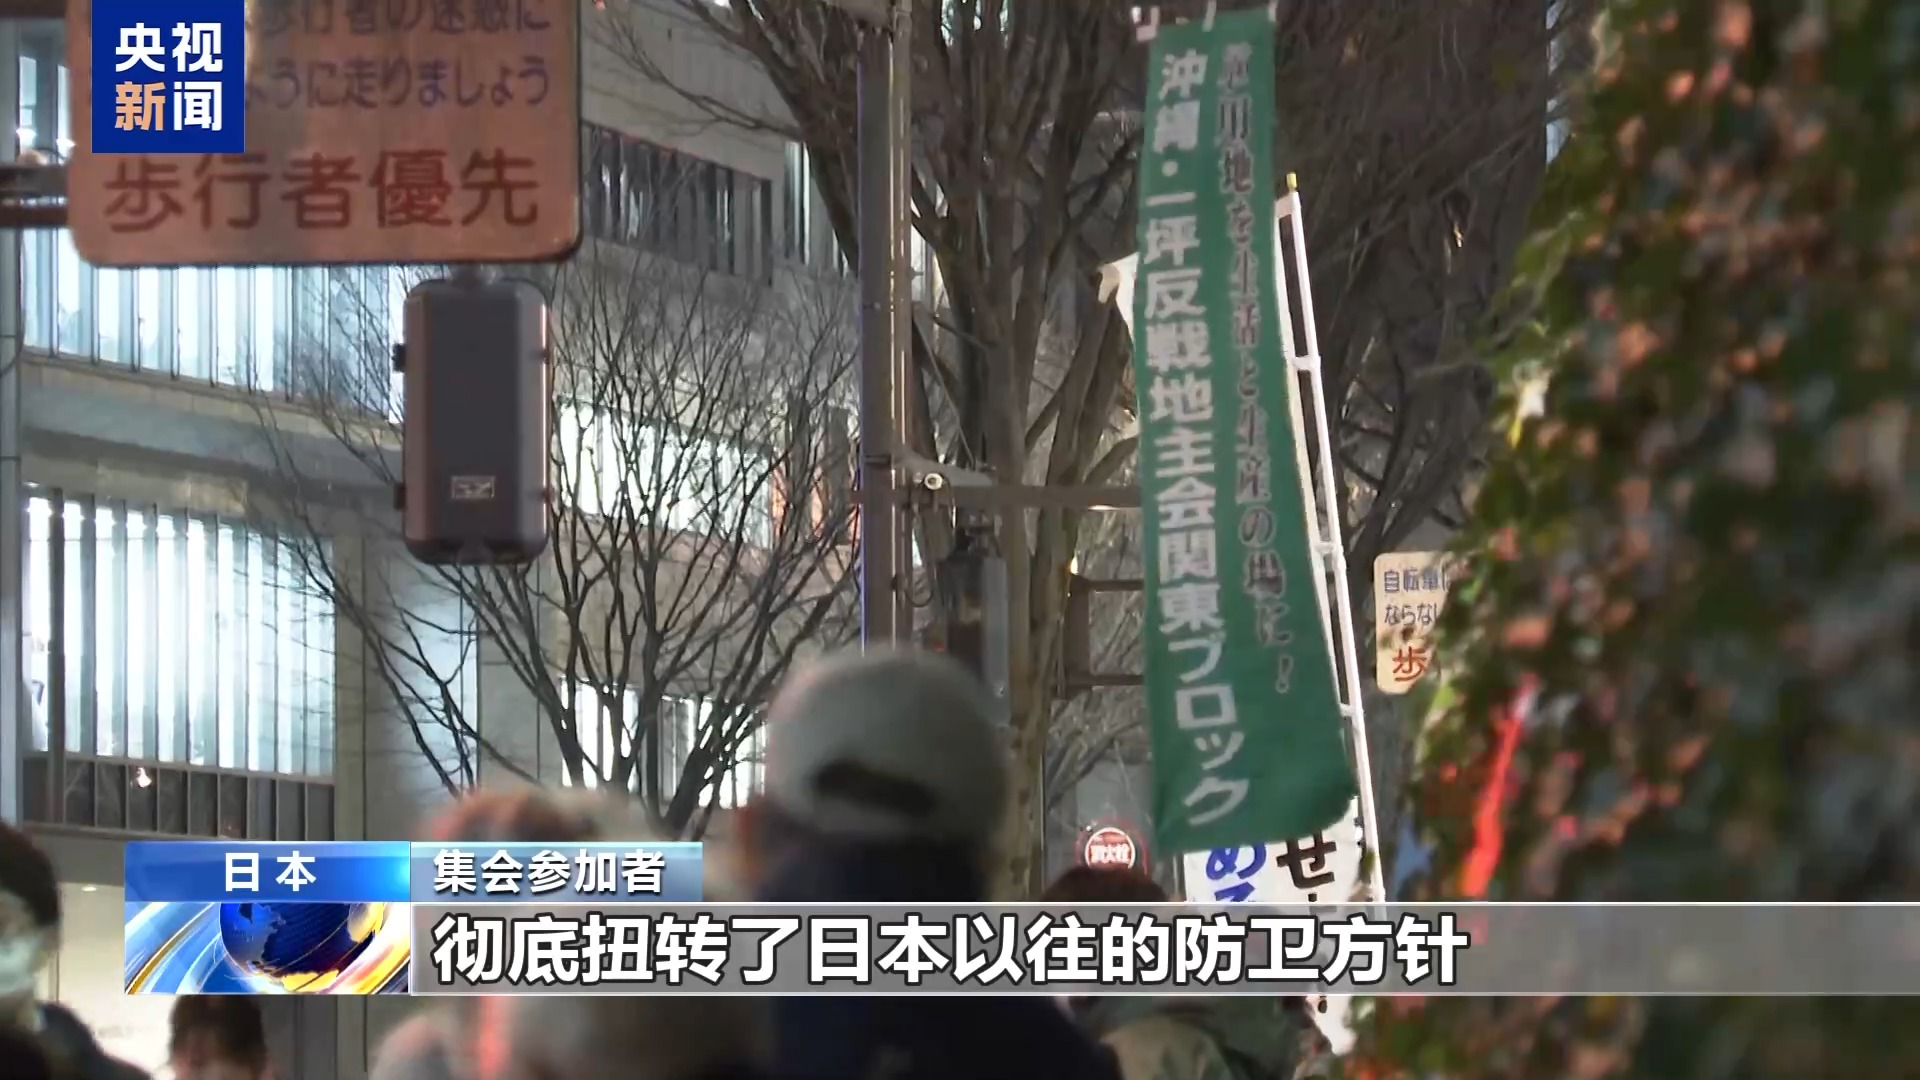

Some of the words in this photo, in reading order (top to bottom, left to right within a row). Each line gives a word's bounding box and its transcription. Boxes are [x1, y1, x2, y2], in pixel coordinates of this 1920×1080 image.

[246, 0, 551, 37] 歩行者の迷惑に
[103, 149, 540, 233] 歩行者優先
